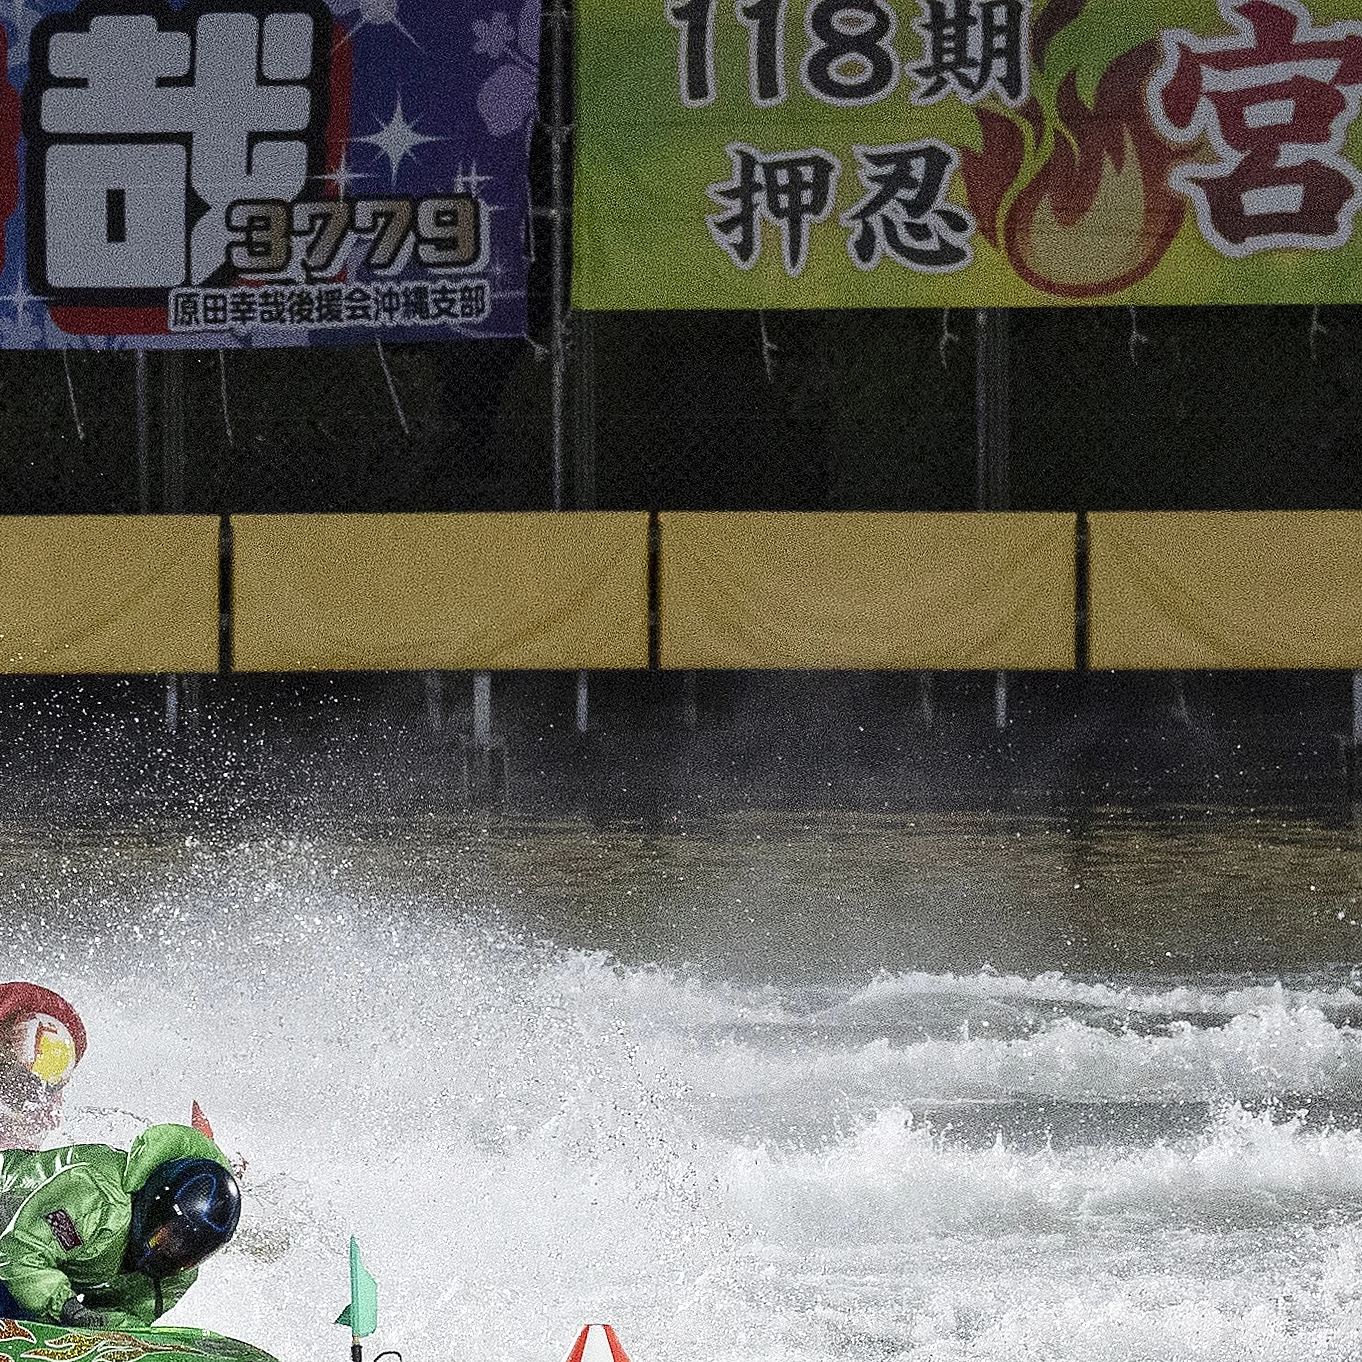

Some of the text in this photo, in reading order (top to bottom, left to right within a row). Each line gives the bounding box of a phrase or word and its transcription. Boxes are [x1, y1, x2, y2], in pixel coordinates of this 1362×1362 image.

[676, 0, 1022, 101] 118期
[1162, 0, 1362, 238] 宮
[226, 199, 480, 273] 3779
[713, 146, 970, 271] 押忍
[175, 286, 486, 326] 原田幸哉後援会沖縄支部
